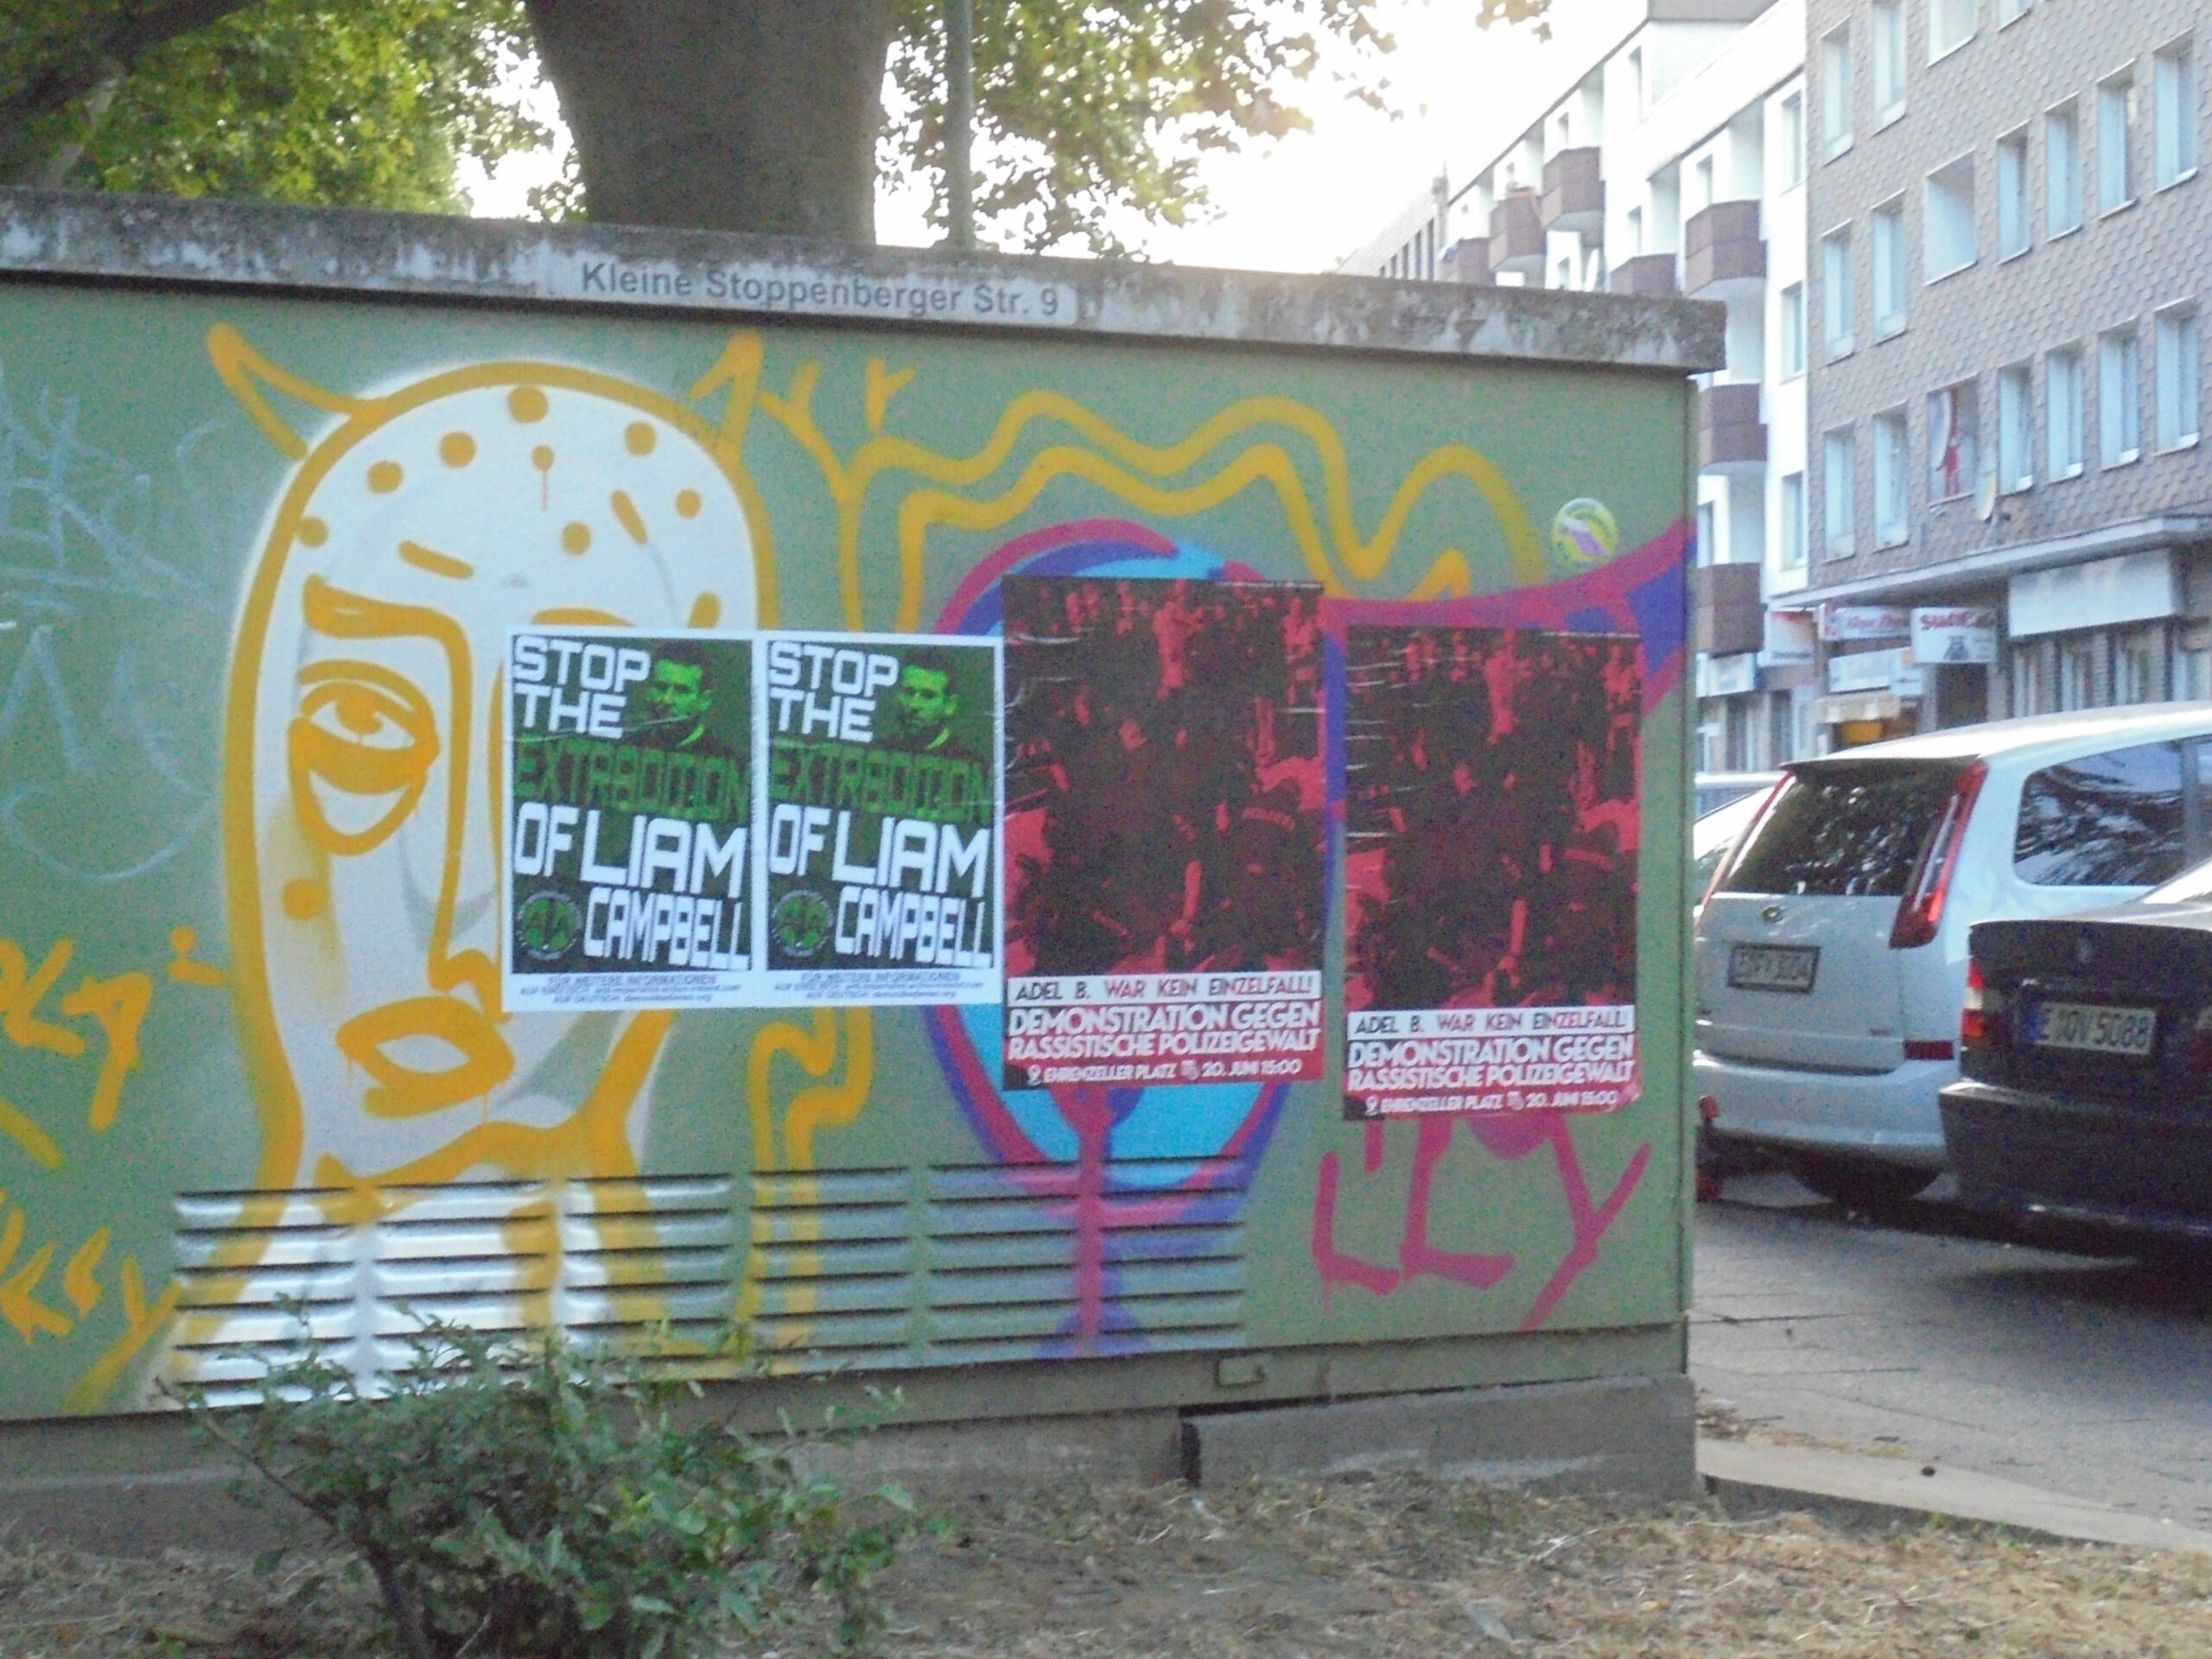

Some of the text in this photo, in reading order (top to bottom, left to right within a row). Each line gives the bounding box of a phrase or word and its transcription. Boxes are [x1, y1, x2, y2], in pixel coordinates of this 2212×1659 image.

[581, 261, 1058, 317] Kleine Stoppenberger Str. 9
[513, 636, 652, 693] STOP
[769, 641, 899, 697] STOP
[515, 684, 626, 738] THE
[771, 689, 876, 742] THE
[513, 801, 747, 899] OF LIAM
[769, 804, 990, 899] OF LIAM
[583, 887, 749, 971] CAMPBELL
[835, 886, 992, 968] CAMPBELL
[1015, 976, 1313, 1001] ADEL B. WAR KEIN EINZELFALL!
[1007, 1028, 1320, 1060] RASSISTISCHE POLIZEIGEWALT
[1008, 1001, 1320, 1036] DEMONSTRATION GEGEN
[1356, 1015, 1398, 1034] ADEL
[1409, 1015, 1425, 1032] B.
[1437, 1014, 1474, 1031] WAR
[1484, 1014, 1522, 1030] KEIN
[1348, 1060, 1635, 1090] RASSISTISCHE POLIZEIGEWALT
[1349, 1034, 1635, 1068] DEMONSTRATION GEGEN
